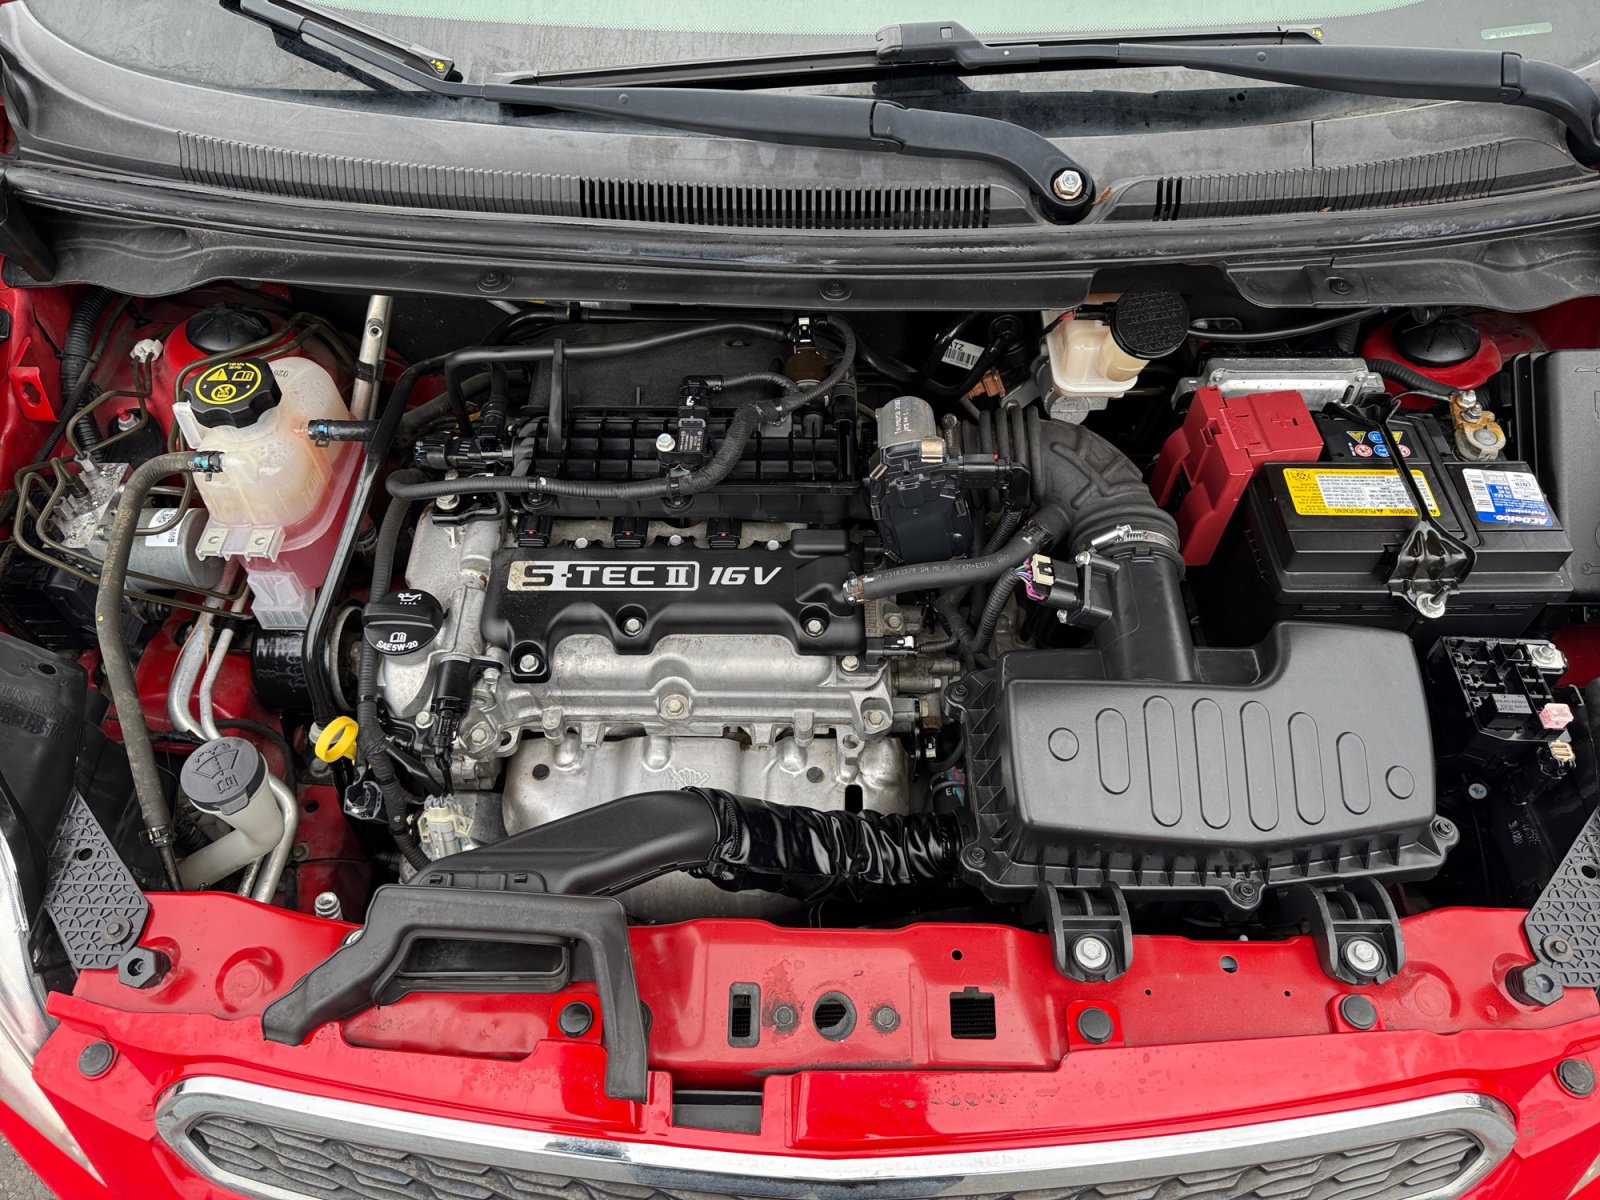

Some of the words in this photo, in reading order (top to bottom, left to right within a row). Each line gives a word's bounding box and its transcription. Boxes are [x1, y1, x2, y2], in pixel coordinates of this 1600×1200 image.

[951, 342, 965, 352] TZ
[1495, 513, 1549, 525] ACDelco
[708, 566, 783, 586] 16V
